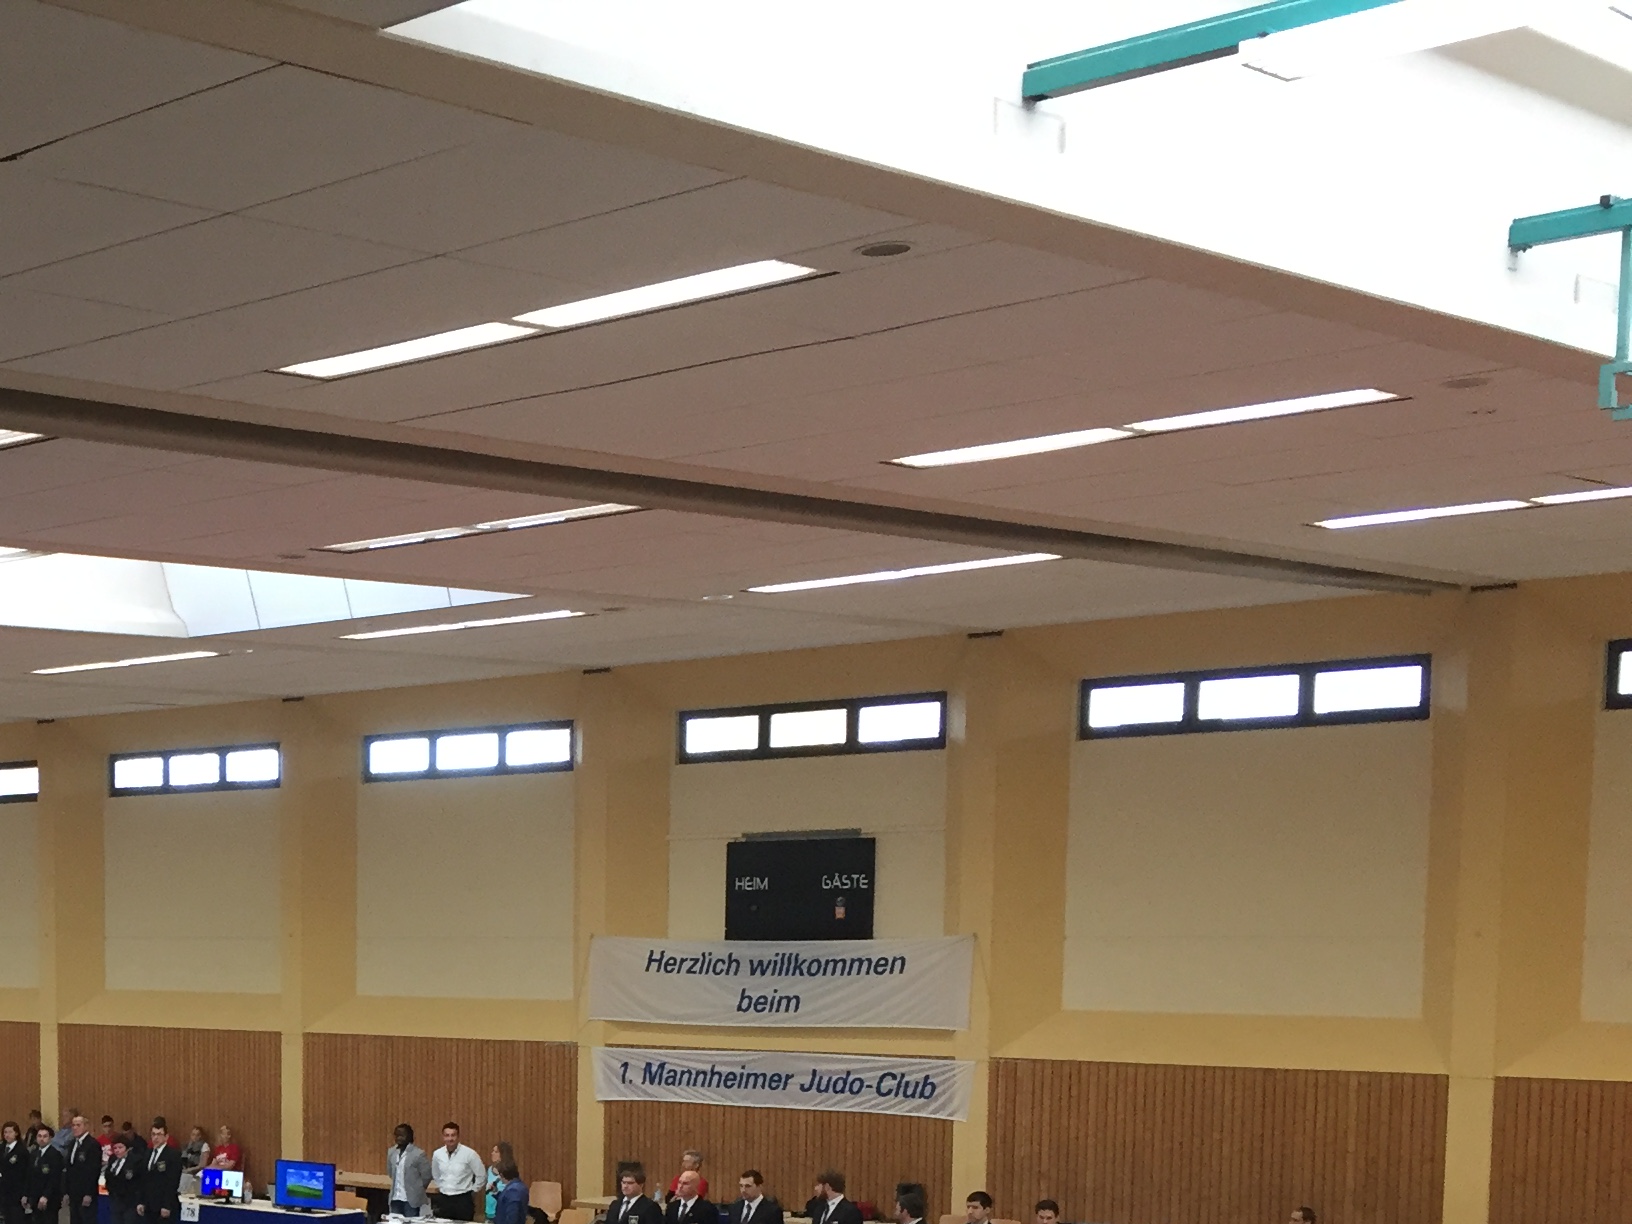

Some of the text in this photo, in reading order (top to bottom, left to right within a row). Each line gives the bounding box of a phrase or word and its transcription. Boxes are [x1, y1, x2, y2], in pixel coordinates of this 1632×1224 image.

[734, 873, 869, 892] HEIM GÄSTE
[644, 949, 907, 979] Herzlich willkommen
[735, 988, 802, 1014] beim
[618, 1061, 938, 1101] 1. Mannheimer Judo-Club
